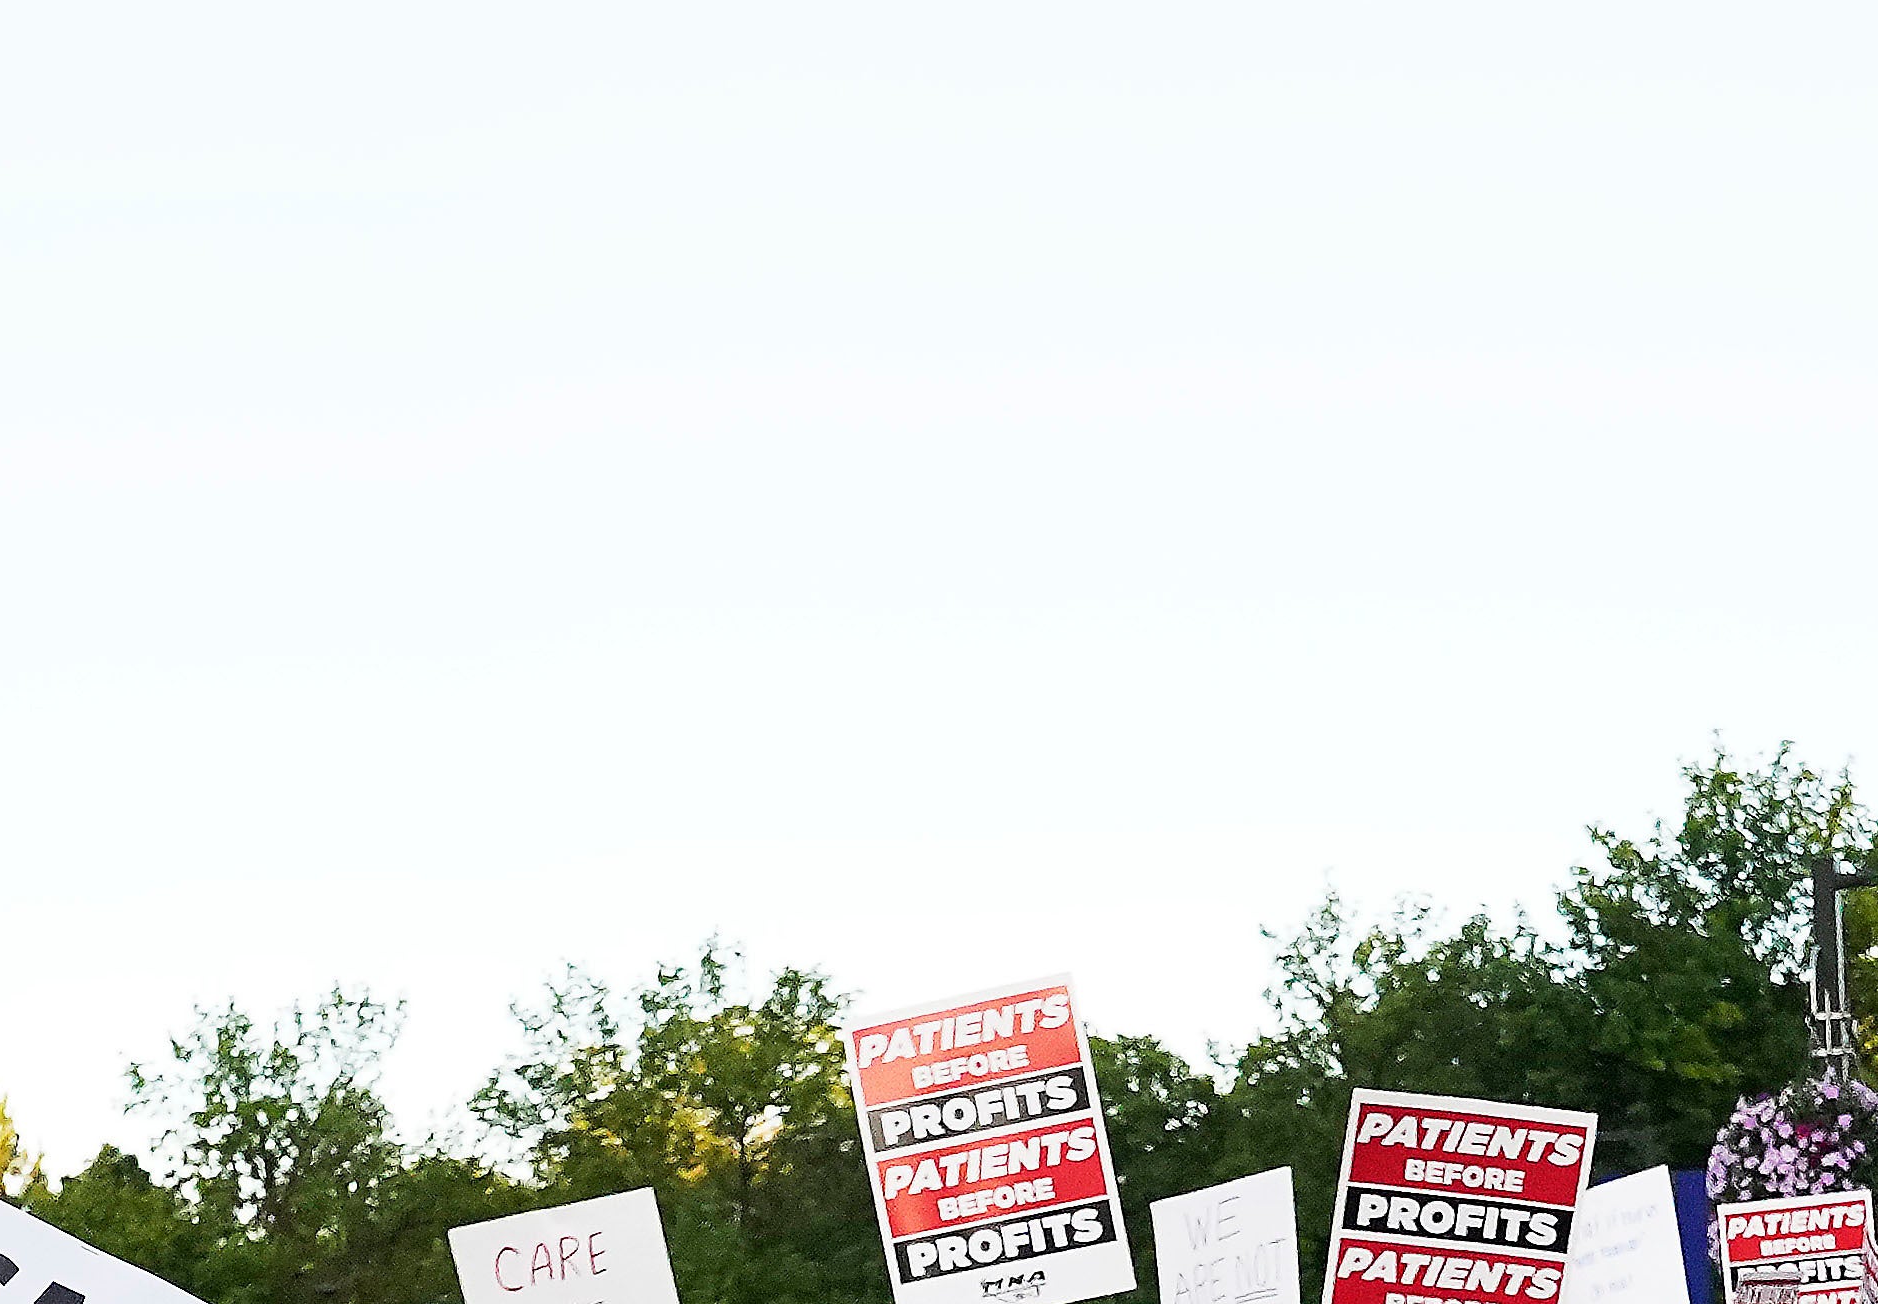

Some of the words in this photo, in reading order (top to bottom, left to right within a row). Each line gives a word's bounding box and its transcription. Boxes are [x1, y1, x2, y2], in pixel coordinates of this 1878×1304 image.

[858, 993, 1071, 1068] PATIENTS
[911, 1044, 1031, 1089] BEFORE
[879, 1074, 1077, 1146] PROFITS
[883, 1126, 1098, 1200] PATIENTS
[1356, 1112, 1585, 1167] PATIENTS
[937, 1178, 1056, 1222] BEFORE
[1404, 1158, 1526, 1193] BEFORE
[906, 1207, 1104, 1278] PROFITS
[1356, 1192, 1559, 1247] PROFITS
[1727, 1204, 1866, 1240] PATIENTS
[494, 1230, 607, 1292] CARE
[1337, 1247, 1563, 1300] PATIENTS
